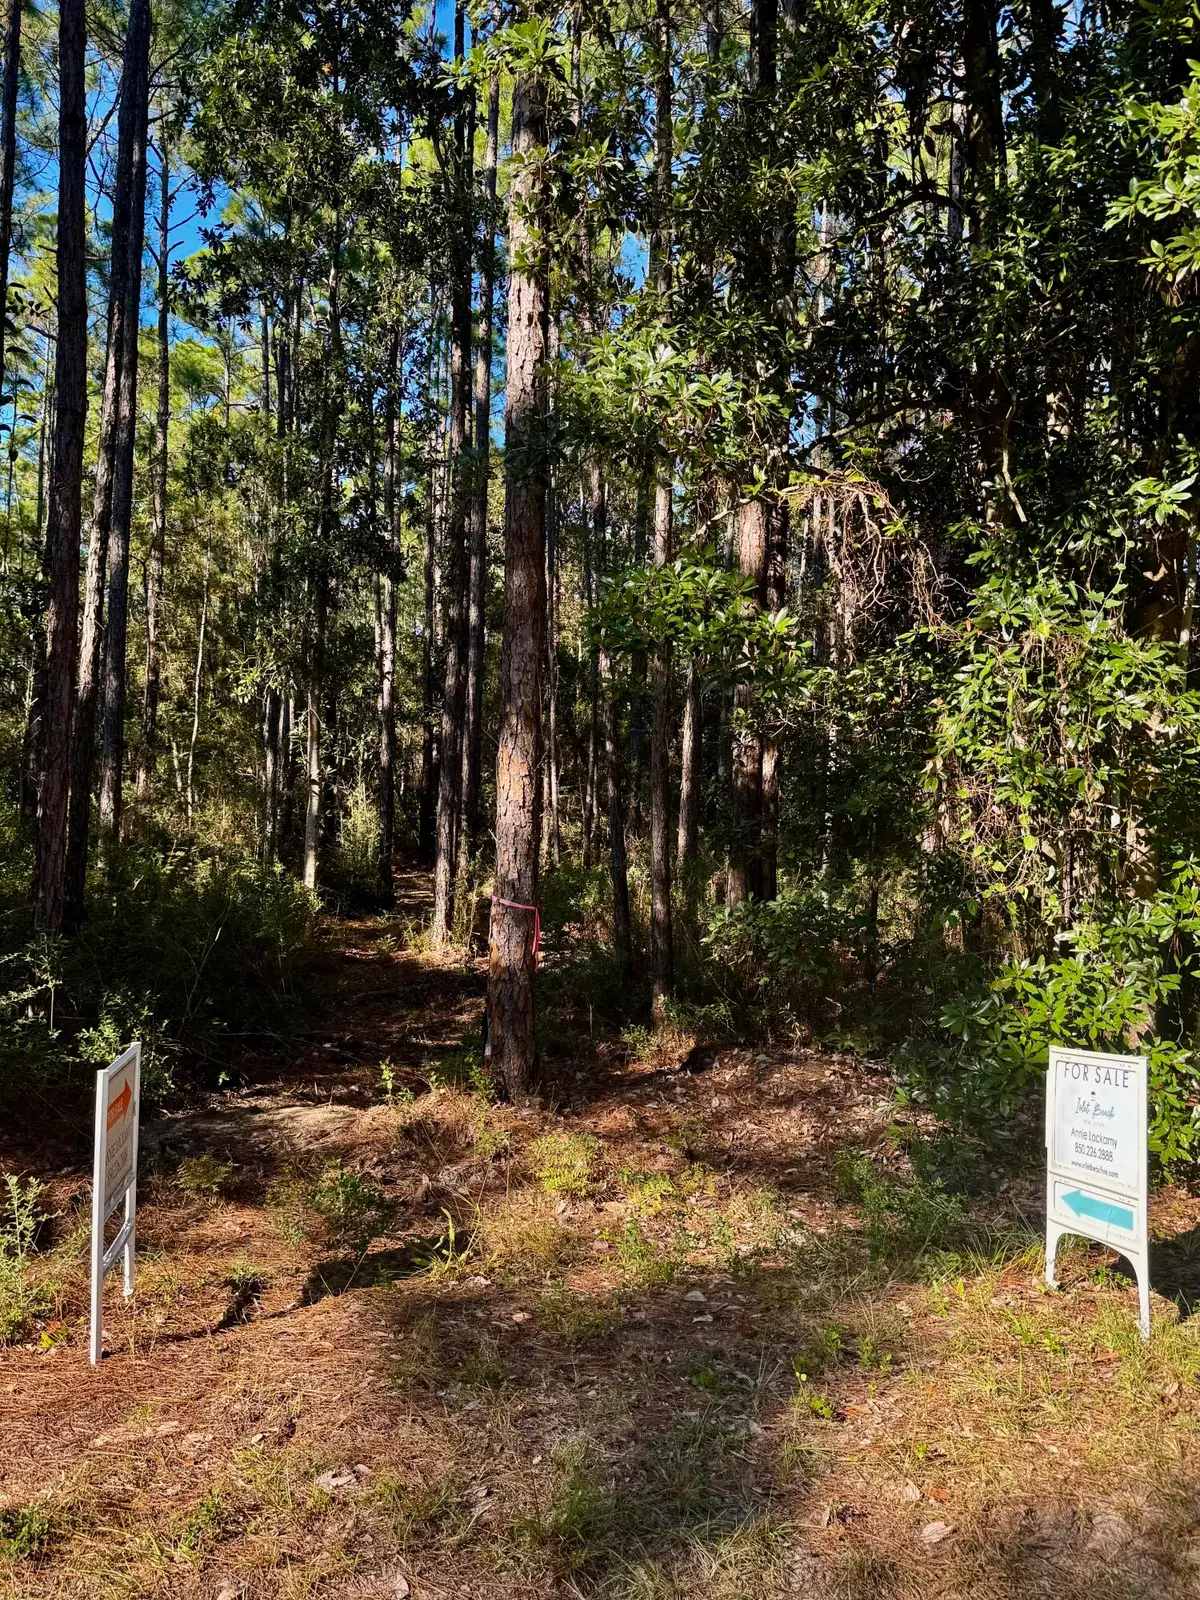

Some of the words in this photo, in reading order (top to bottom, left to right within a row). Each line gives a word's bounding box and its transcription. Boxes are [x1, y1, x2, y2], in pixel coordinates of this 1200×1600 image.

[1064, 1062, 1088, 1082] FOR
[1095, 1066, 1129, 1088] SALE
[1070, 1127, 1088, 1141] Annie
[1089, 1131, 1118, 1149] Lockamy
[1074, 1142, 1114, 1163] 850.226.2888
